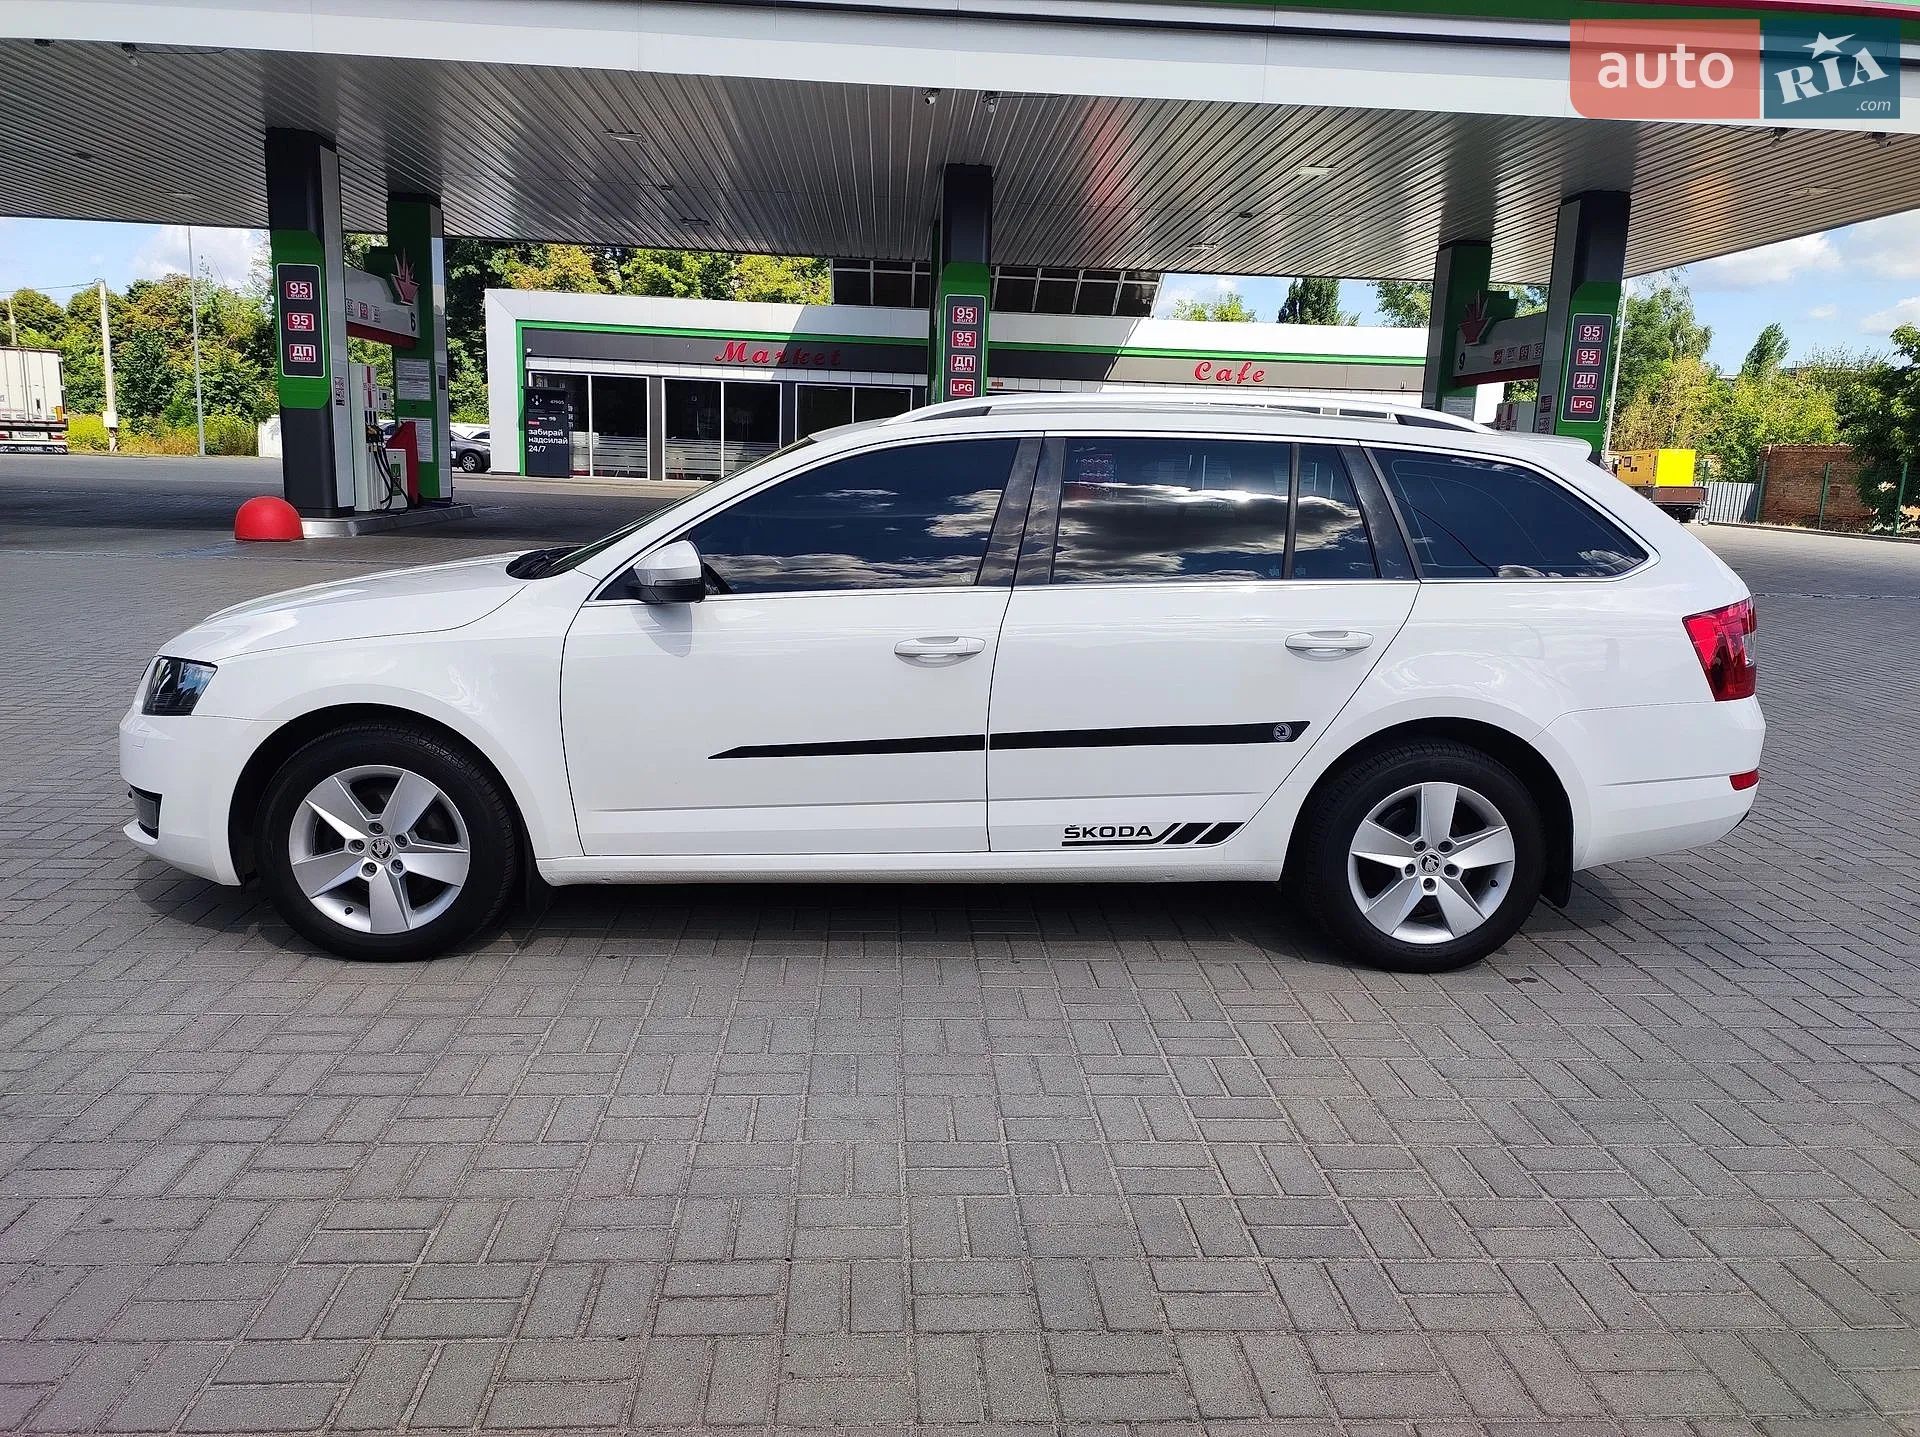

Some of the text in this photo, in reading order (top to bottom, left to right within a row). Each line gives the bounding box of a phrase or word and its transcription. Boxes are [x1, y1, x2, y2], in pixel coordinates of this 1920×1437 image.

[289, 282, 309, 295] 95
[957, 307, 974, 319] 95
[291, 314, 309, 326] 95
[410, 312, 416, 332] 6
[1583, 326, 1600, 337] 95
[956, 332, 972, 343] 95
[292, 346, 312, 357] ДП
[714, 340, 841, 366] Market
[1581, 350, 1596, 361] 95
[954, 356, 973, 367] ДП
[1458, 351, 1466, 370] 9
[1194, 361, 1265, 384] Cafe
[1577, 374, 1595, 385] ДП
[952, 383, 973, 392] LPG
[1573, 400, 1593, 409] LPG
[528, 428, 564, 437] забирай
[528, 437, 568, 445] надсилай
[1064, 825, 1152, 839] ŠKODA
